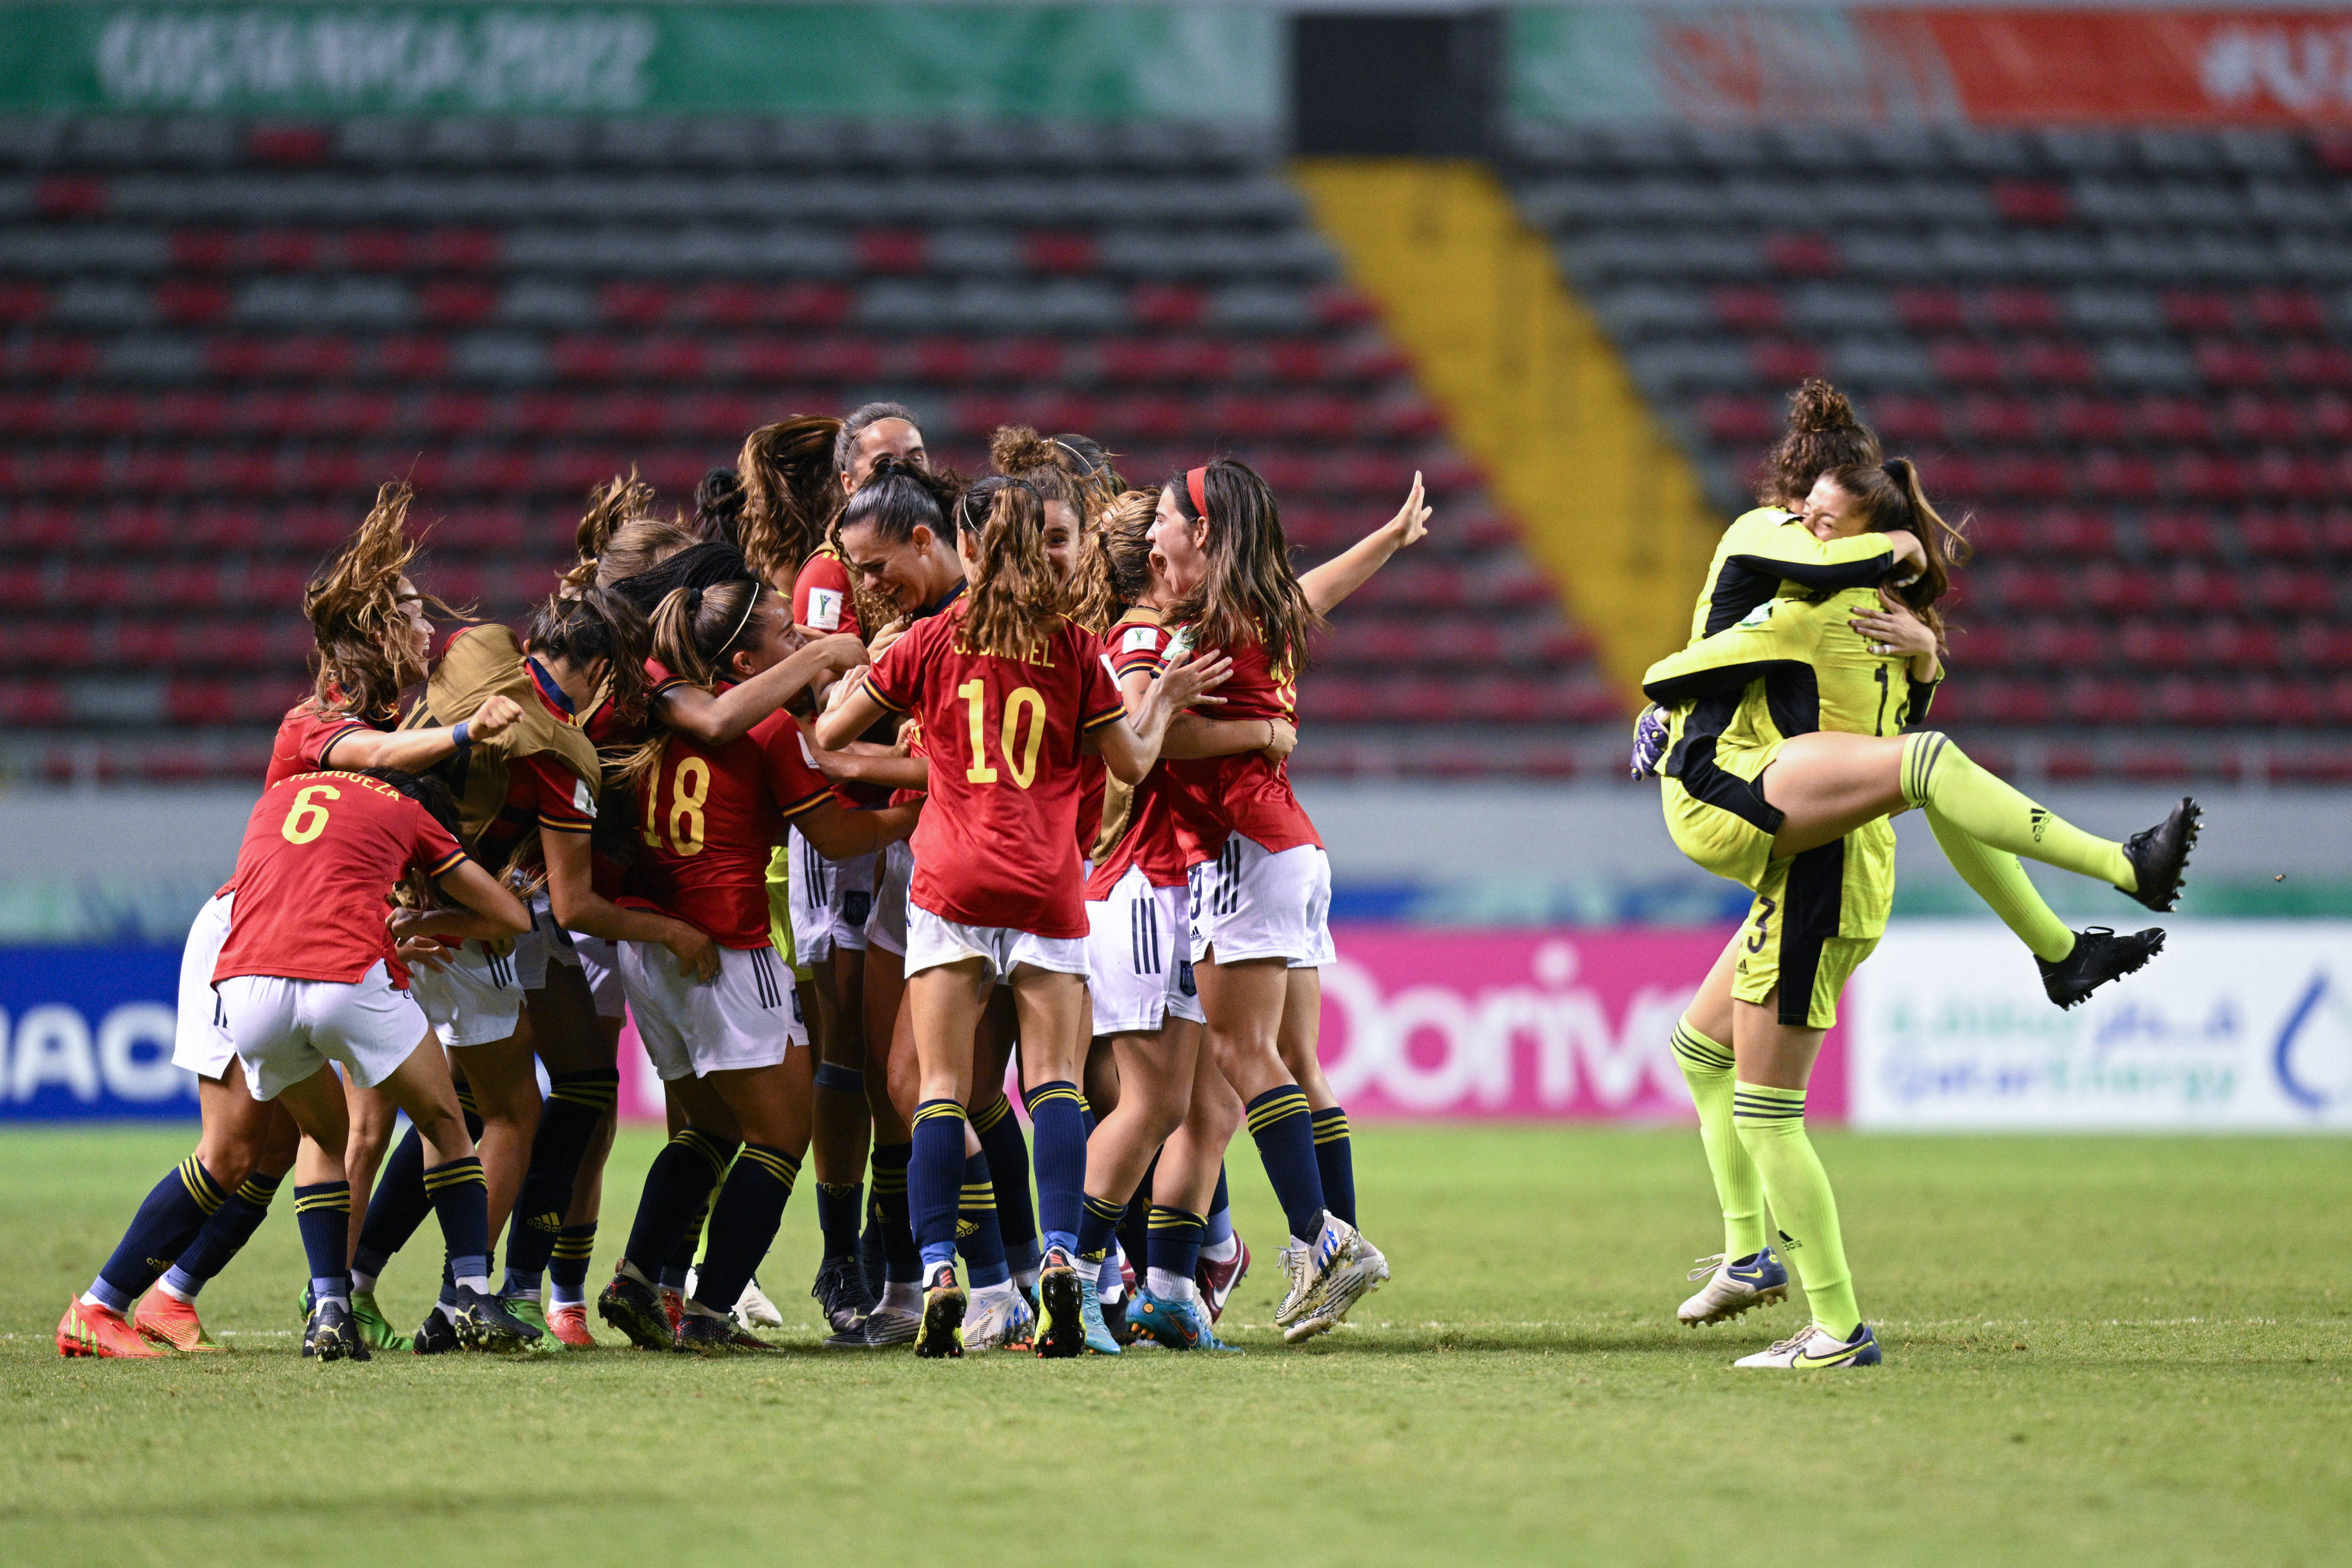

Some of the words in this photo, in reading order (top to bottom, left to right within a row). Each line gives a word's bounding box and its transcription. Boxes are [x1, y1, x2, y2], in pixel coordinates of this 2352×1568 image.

[958, 678, 1047, 790] 10
[282, 785, 340, 845] 6
[644, 756, 710, 856] 18
[527, 1218, 563, 1233] adidas
